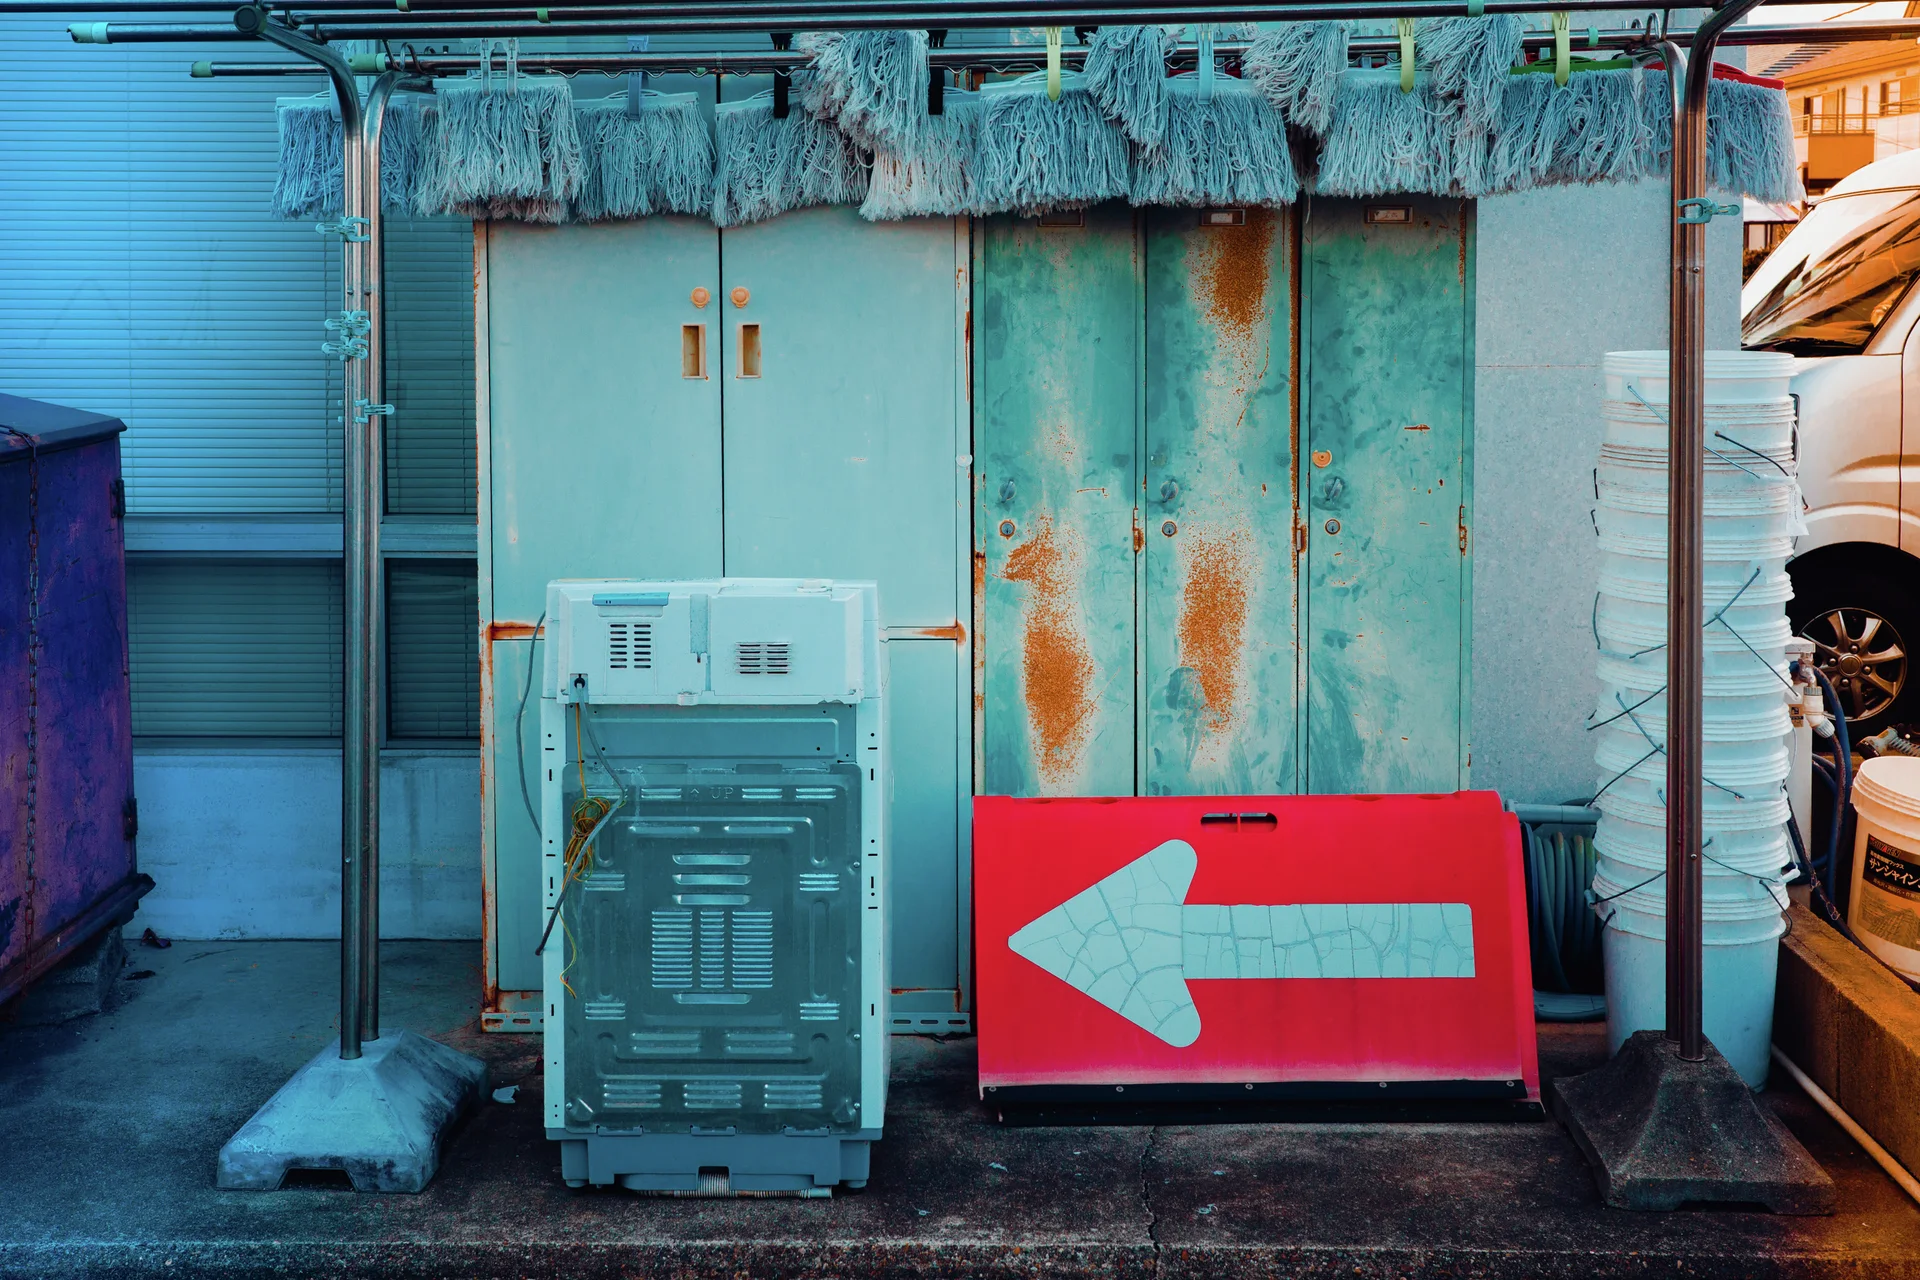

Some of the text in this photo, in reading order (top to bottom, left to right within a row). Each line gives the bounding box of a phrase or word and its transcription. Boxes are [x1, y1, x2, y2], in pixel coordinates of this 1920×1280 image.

[710, 786, 733, 799] UP
[1869, 858, 1920, 889] サンシャイン
